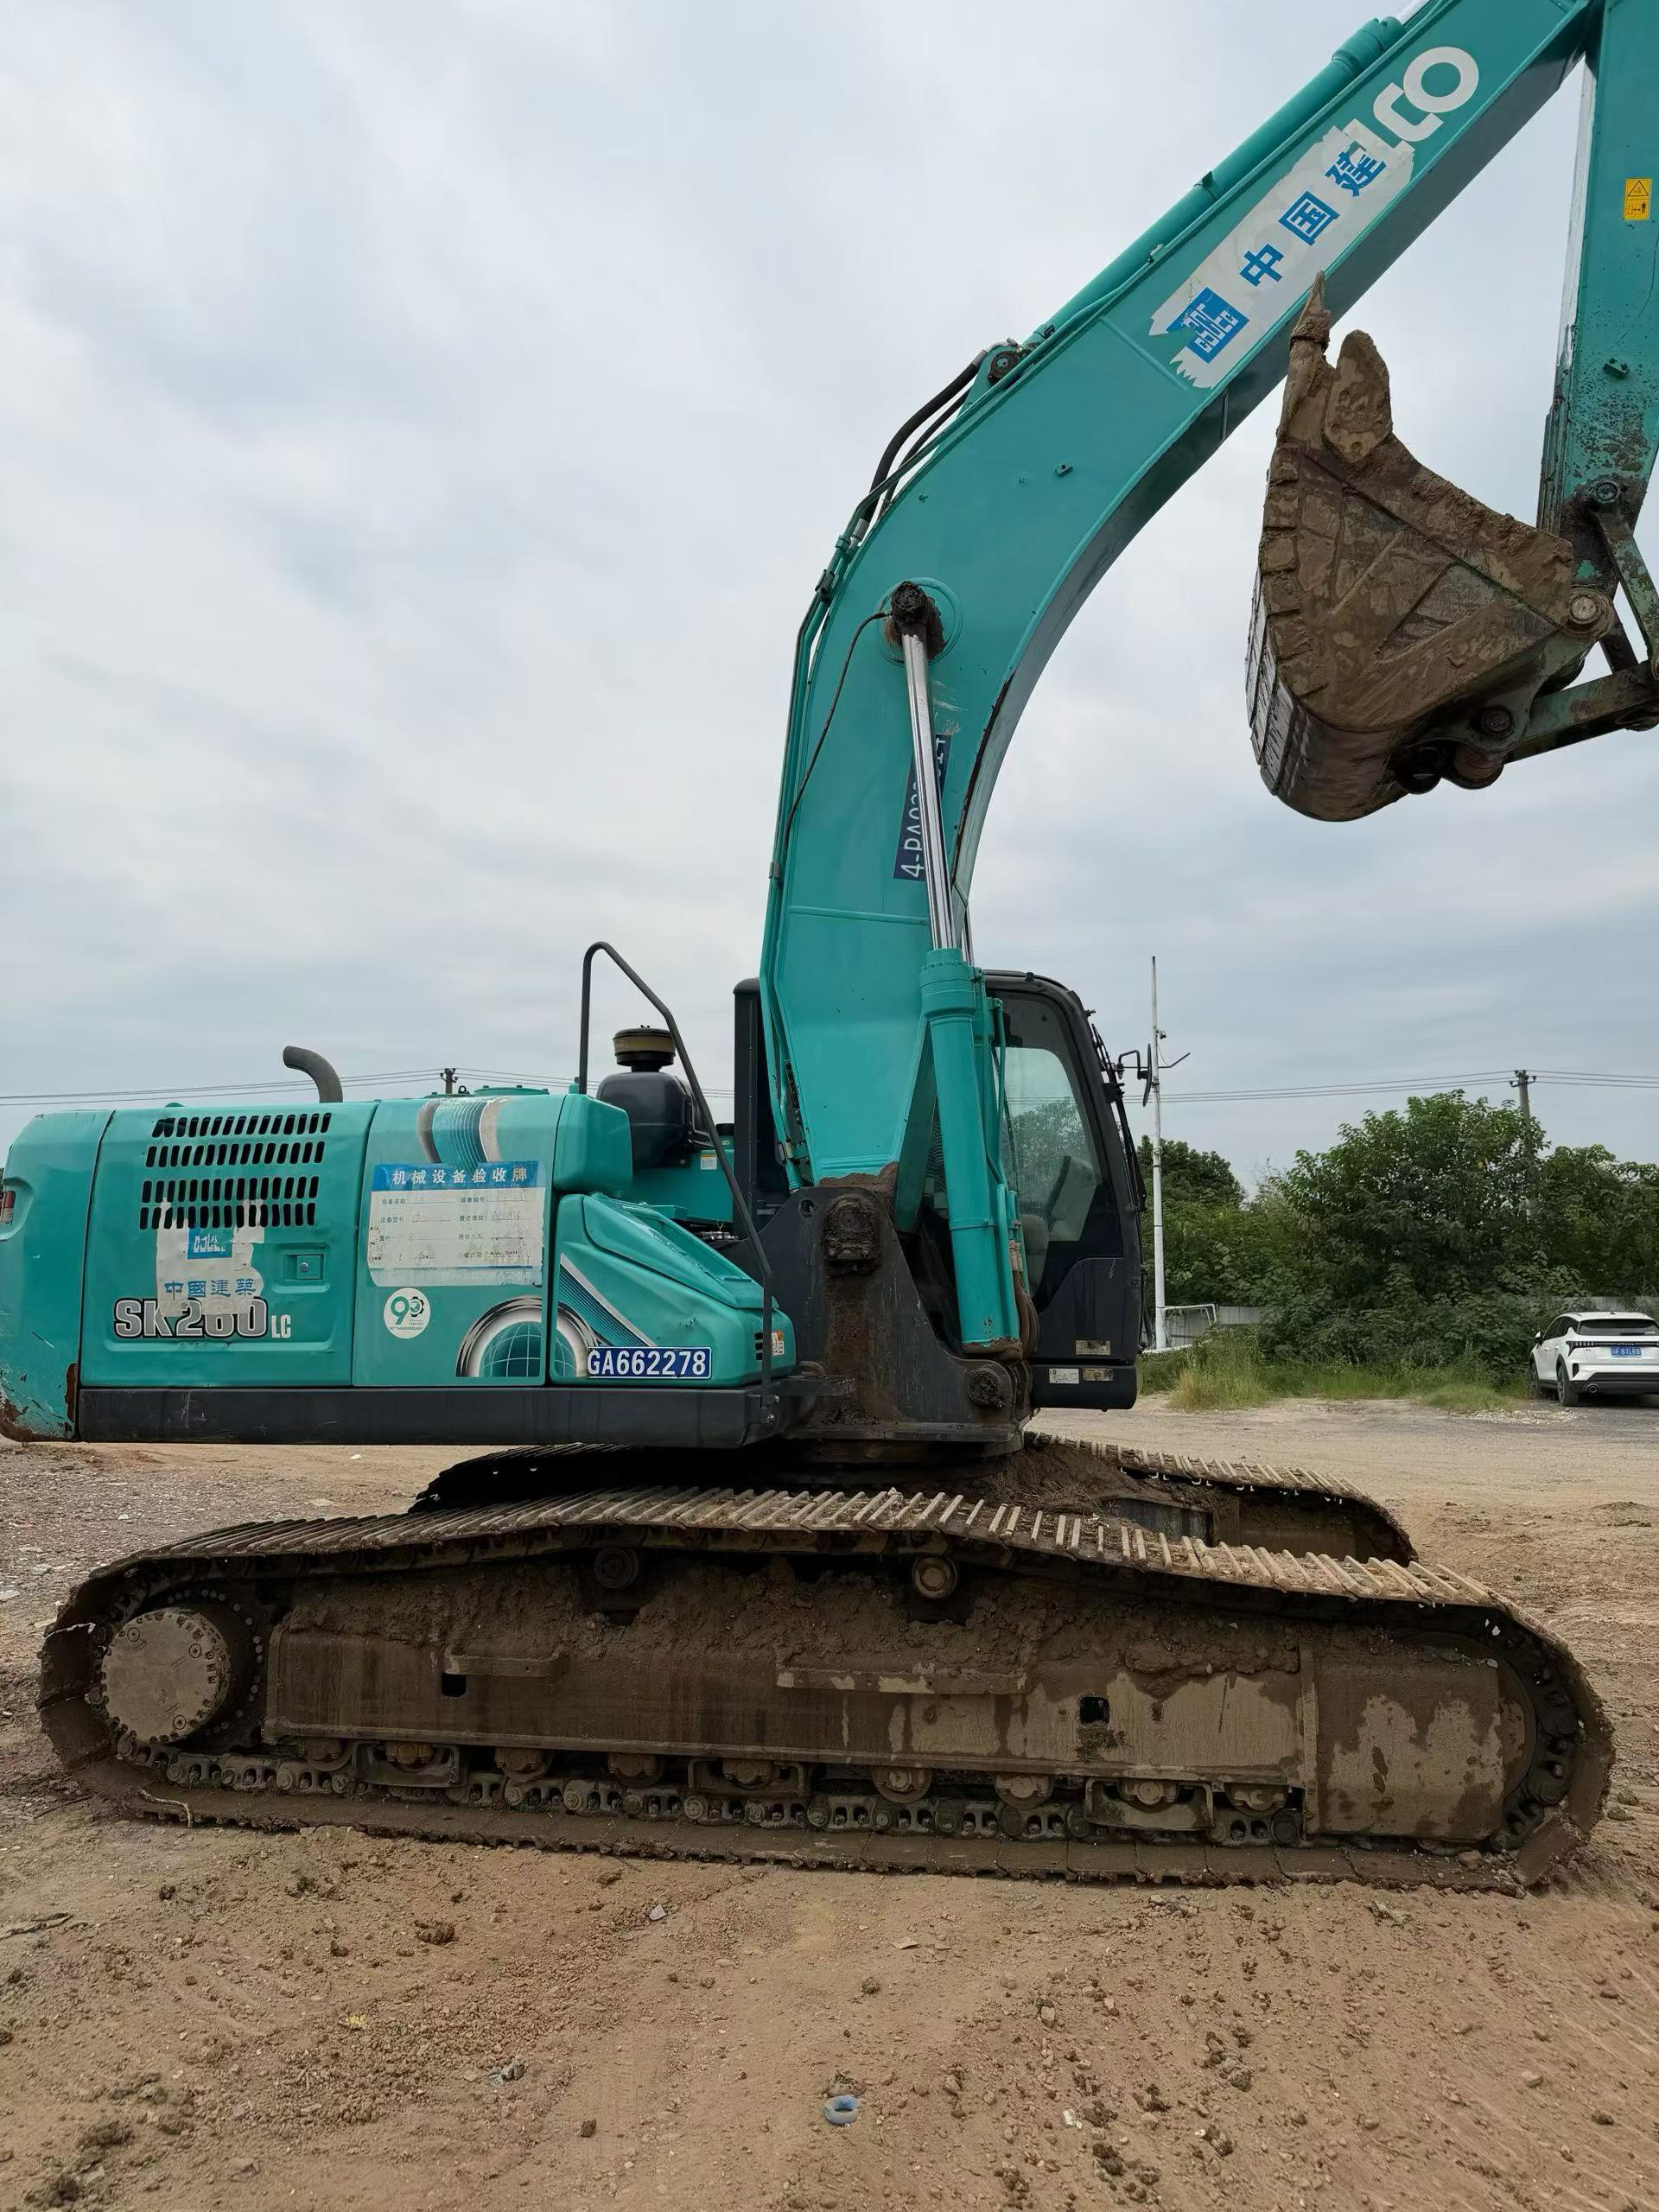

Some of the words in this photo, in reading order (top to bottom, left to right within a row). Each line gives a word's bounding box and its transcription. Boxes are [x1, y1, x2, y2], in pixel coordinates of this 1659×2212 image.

[392, 1166, 527, 1185] 机械设备验收牌
[270, 1314, 292, 1338] LC
[588, 1350, 706, 1376] GA662278
